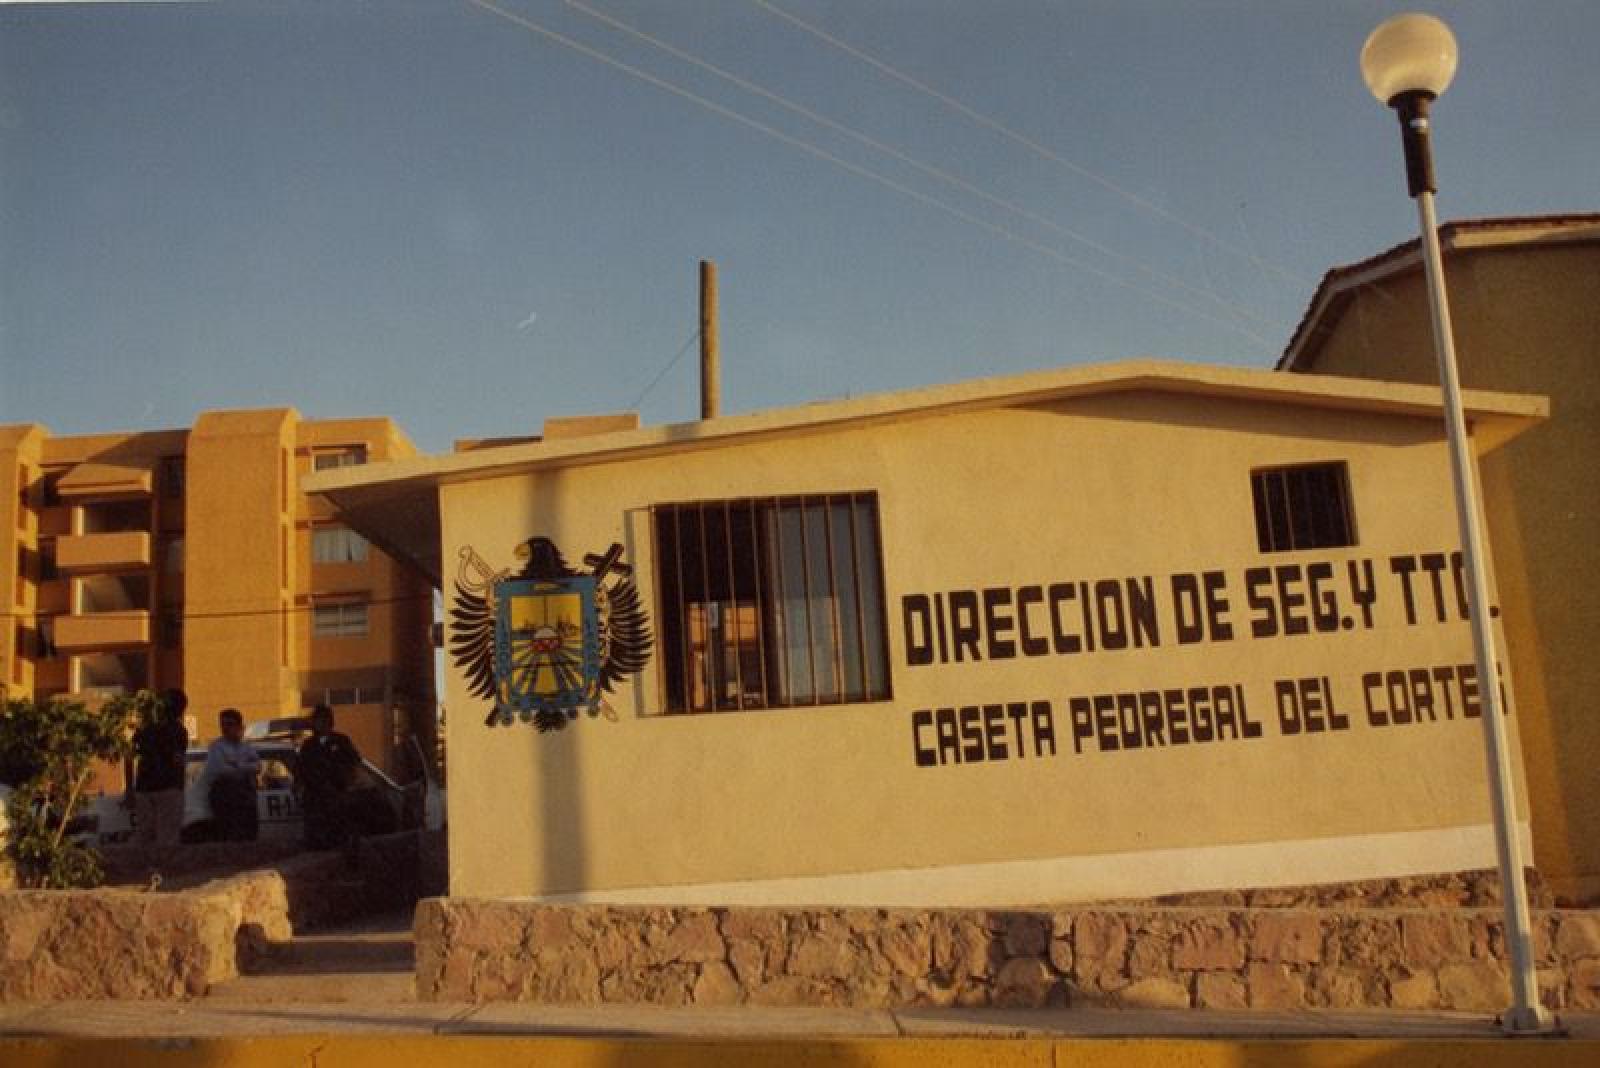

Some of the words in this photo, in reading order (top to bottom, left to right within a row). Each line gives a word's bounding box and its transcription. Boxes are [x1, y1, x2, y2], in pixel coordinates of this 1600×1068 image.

[902, 576, 1160, 666] DIRECCION
[1170, 570, 1234, 645] DE
[912, 700, 1056, 767] CASETA
[1069, 683, 1263, 754] PEDREGAL
[1275, 675, 1350, 735] DEL
[1362, 661, 1509, 728] CORTE
